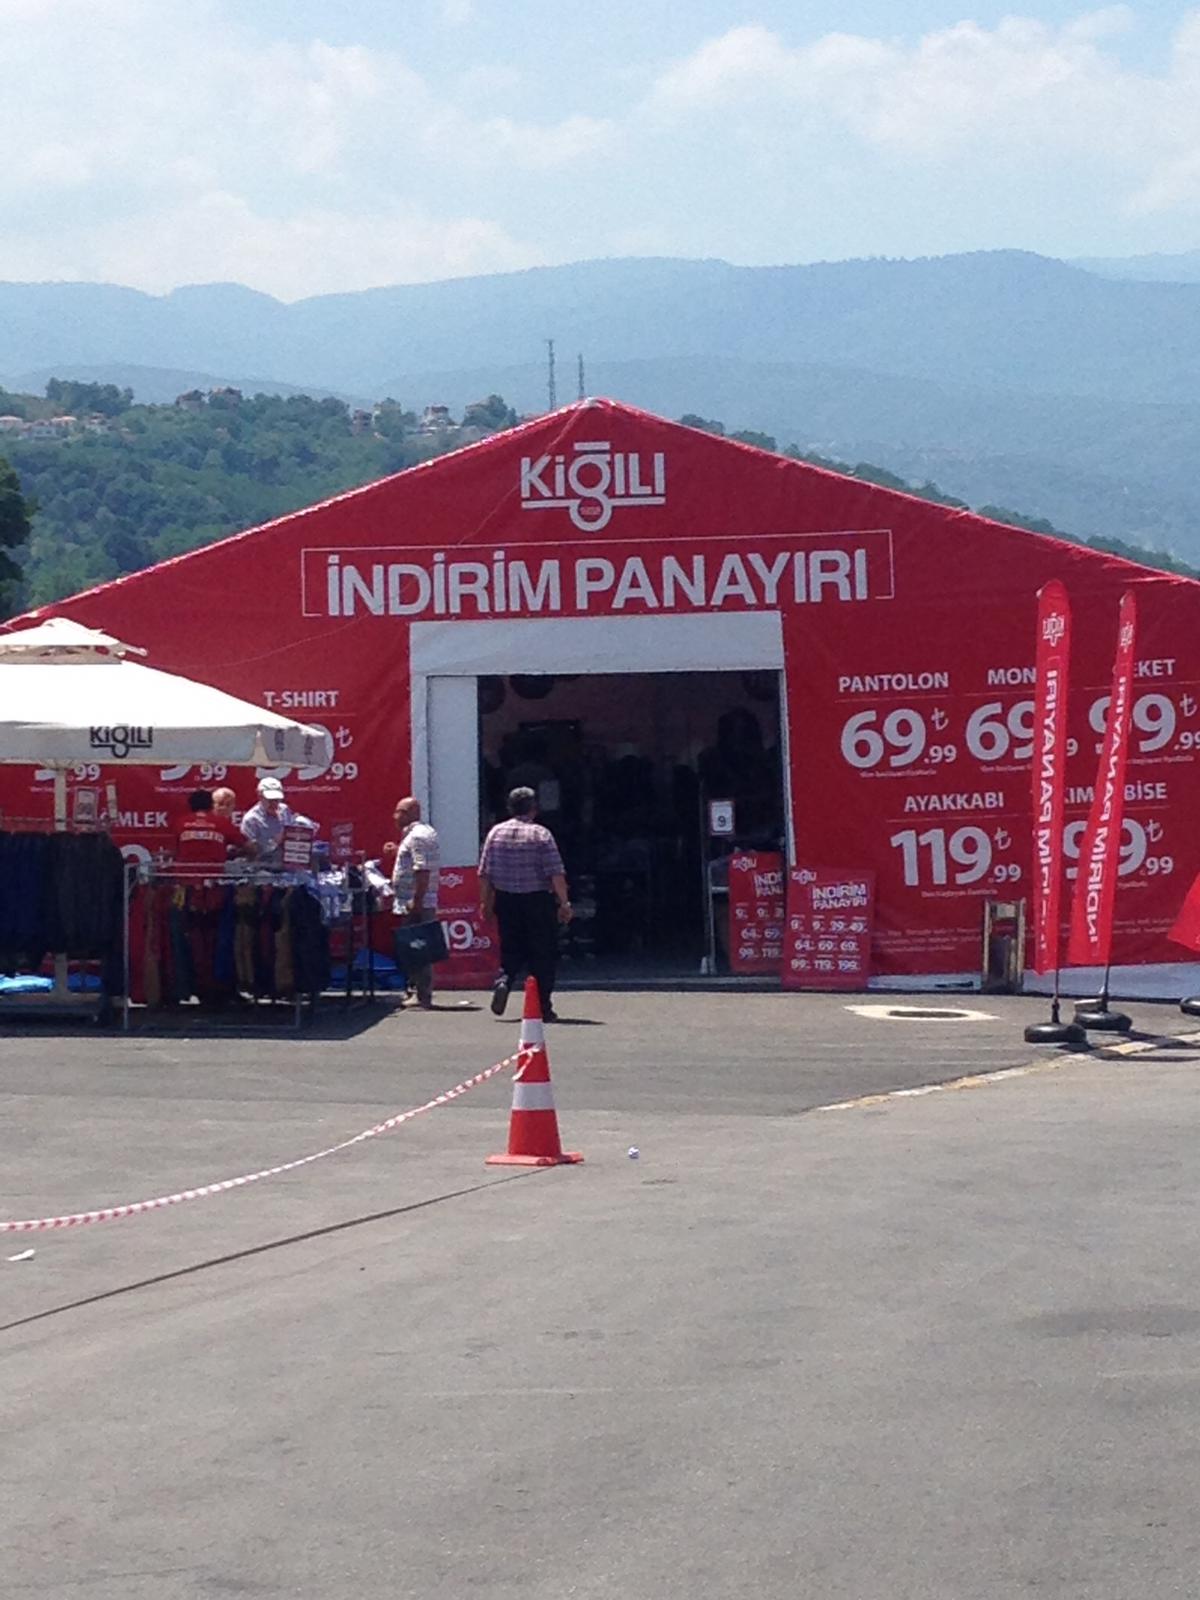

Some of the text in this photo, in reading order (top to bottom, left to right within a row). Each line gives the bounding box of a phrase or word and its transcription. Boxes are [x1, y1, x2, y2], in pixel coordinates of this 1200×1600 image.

[327, 548, 867, 616] İNDİRİM PANAYIRI
[839, 672, 949, 692] PANTOLON
[988, 667, 1037, 685] MON
[263, 690, 339, 707] T-SHIRT
[904, 792, 1004, 812] AYAKKABI
